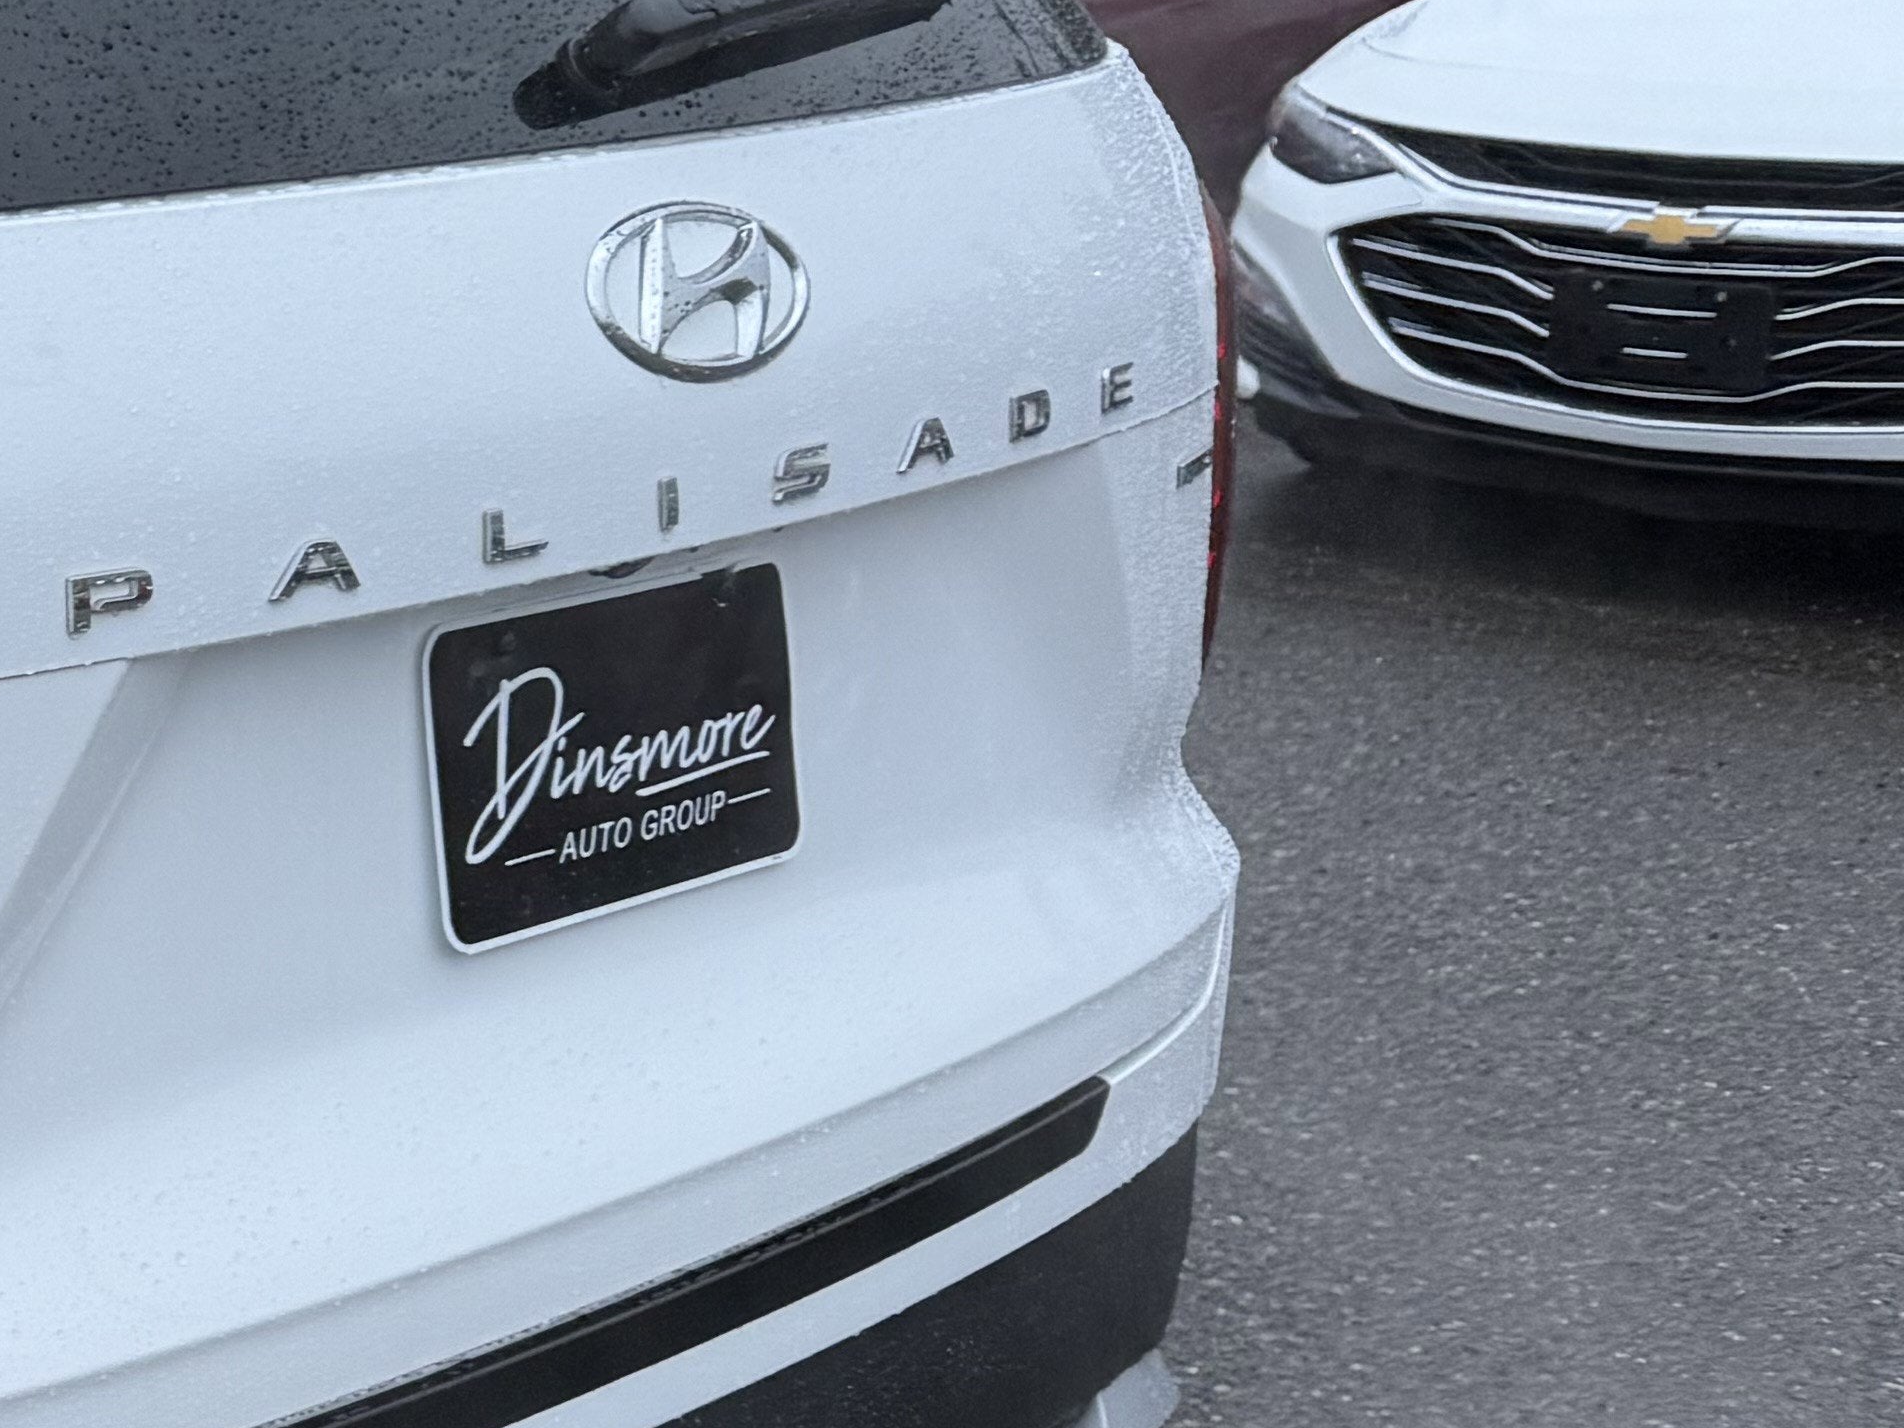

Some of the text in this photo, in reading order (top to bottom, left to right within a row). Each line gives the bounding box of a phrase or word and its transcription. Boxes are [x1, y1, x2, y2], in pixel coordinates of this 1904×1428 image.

[65, 361, 1135, 635] PALISADE
[463, 667, 775, 864] Dinsmore
[558, 789, 726, 864] AUTO GROUP
